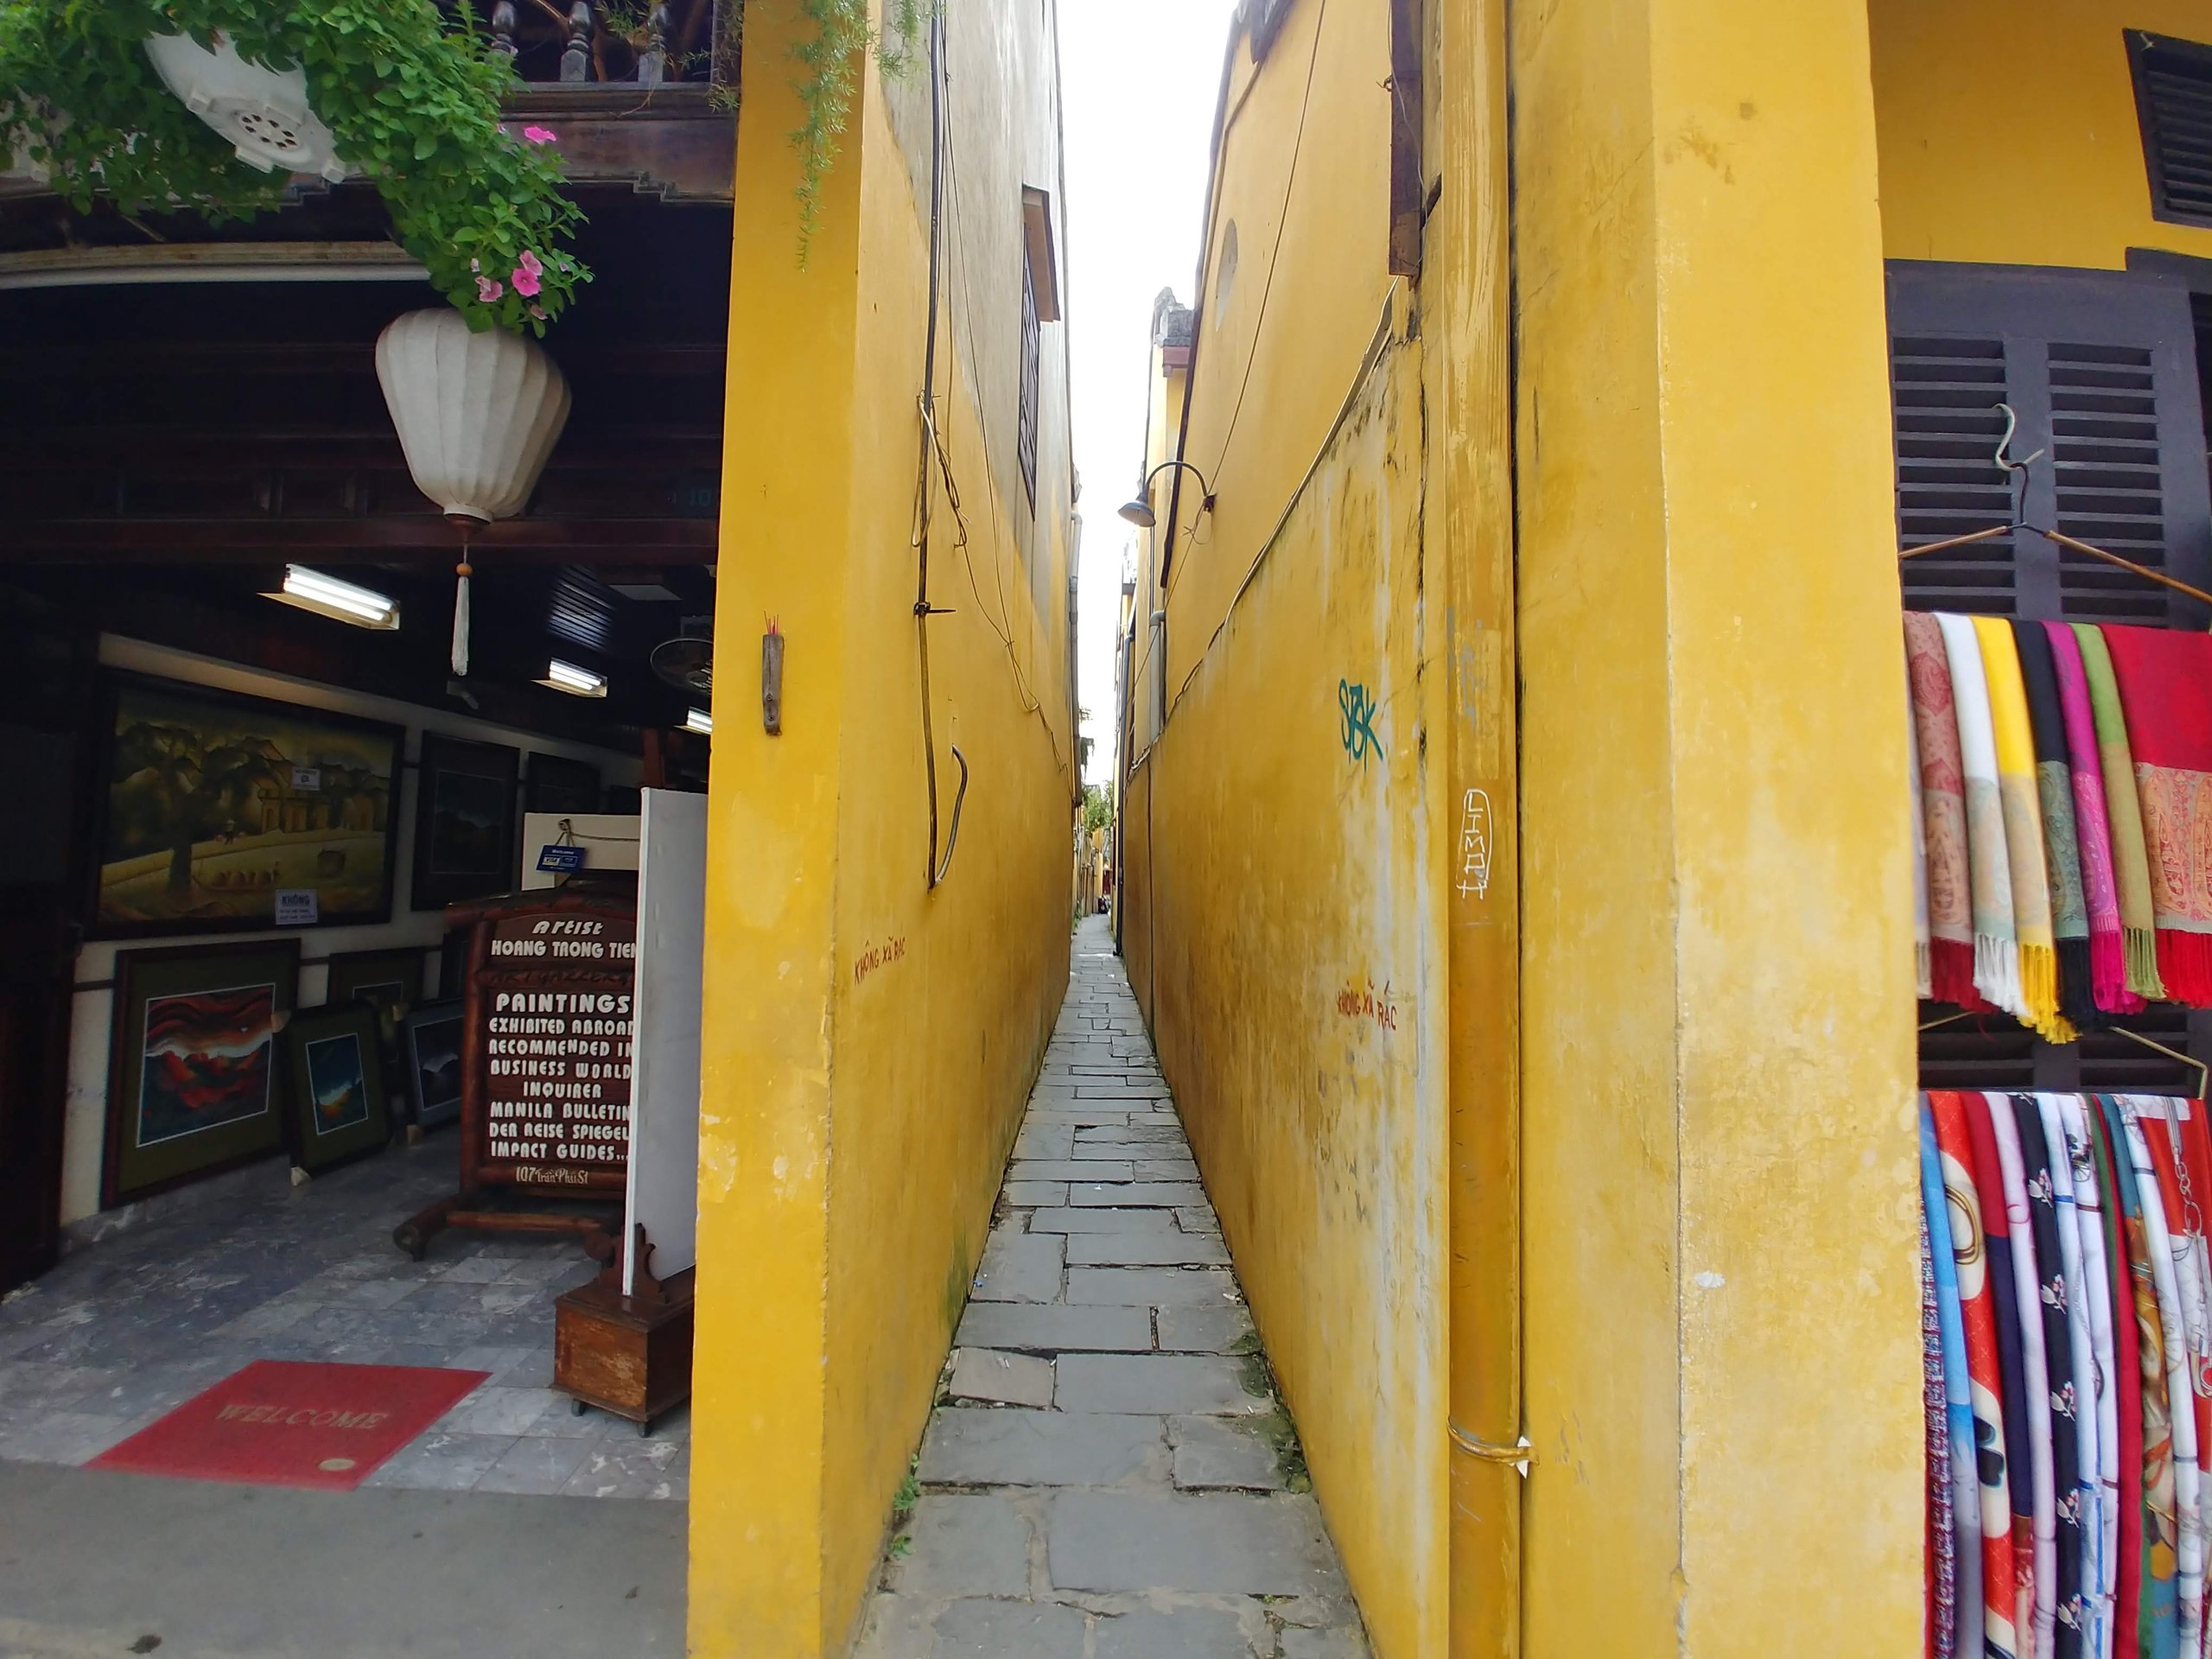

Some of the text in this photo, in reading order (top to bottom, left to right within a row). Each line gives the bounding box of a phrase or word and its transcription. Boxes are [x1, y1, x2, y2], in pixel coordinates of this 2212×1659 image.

[491, 939, 547, 957] HOANG
[552, 941, 605, 959] TRONG
[495, 993, 632, 1014] PAINTINGS
[1376, 980, 1397, 1031] RÁC
[488, 1017, 566, 1035] EXHIBITED
[488, 1039, 610, 1057] RECOMMENDED
[490, 1059, 632, 1079] BUSINESS WORLD
[523, 1081, 602, 1099] INQUIRER
[490, 1101, 631, 1121] MANILA BULLETIN
[489, 1122, 630, 1141] DER REISE SPIEGEL
[491, 1141, 548, 1159] IMPACT
[516, 1166, 536, 1182] 107
[215, 1404, 388, 1430] WELCOME
